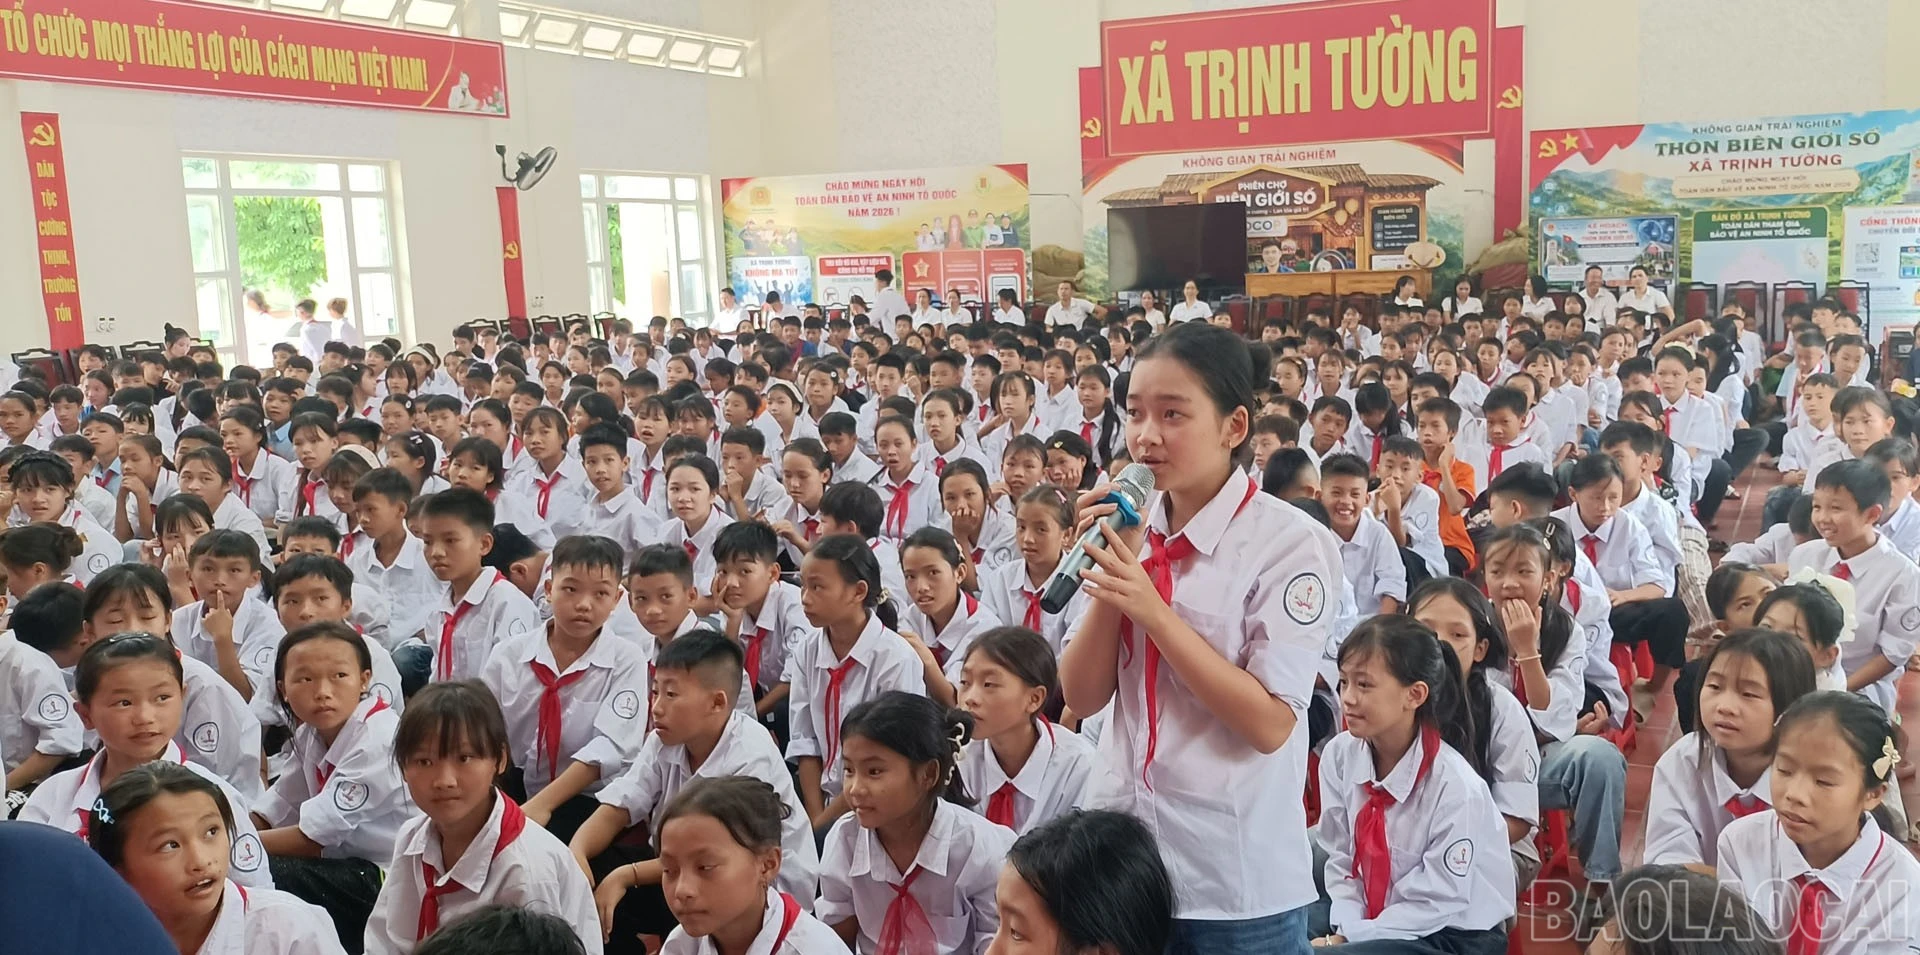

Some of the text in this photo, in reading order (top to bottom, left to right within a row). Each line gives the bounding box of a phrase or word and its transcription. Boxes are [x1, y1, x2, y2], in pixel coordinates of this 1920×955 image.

[0, 0, 429, 95] TỔ CHỨC MỌI THẮNG LỢI CỦA CÁCH MẠNG VIỆT NAM!
[1119, 14, 1478, 133] XÃ TRỊNH TƯỜNG
[1692, 125, 1732, 135] KHÔNG
[1735, 123, 1763, 132] GIAN
[1655, 127, 1880, 157] THÔN BIÊN GIỚI SỐ
[1182, 149, 1336, 168] KHÔNG GIAN TRẢI NGHIỆM
[1689, 154, 1842, 173] XÃ TRỊNH TƯỜNG
[36, 160, 55, 178] DÂN
[1238, 180, 1287, 191] PHIÊN CHỢ
[41, 189, 58, 210] TỘC
[877, 193, 889, 202] AN
[892, 192, 915, 201] NINH
[1255, 189, 1290, 207] GIỚI
[1293, 187, 1317, 205] SỐ
[872, 207, 894, 216] 2026
[1892, 216, 1920, 225] THÔN
[39, 218, 67, 236] CƯỜNG
[43, 275, 76, 294] TRƯỜNG
